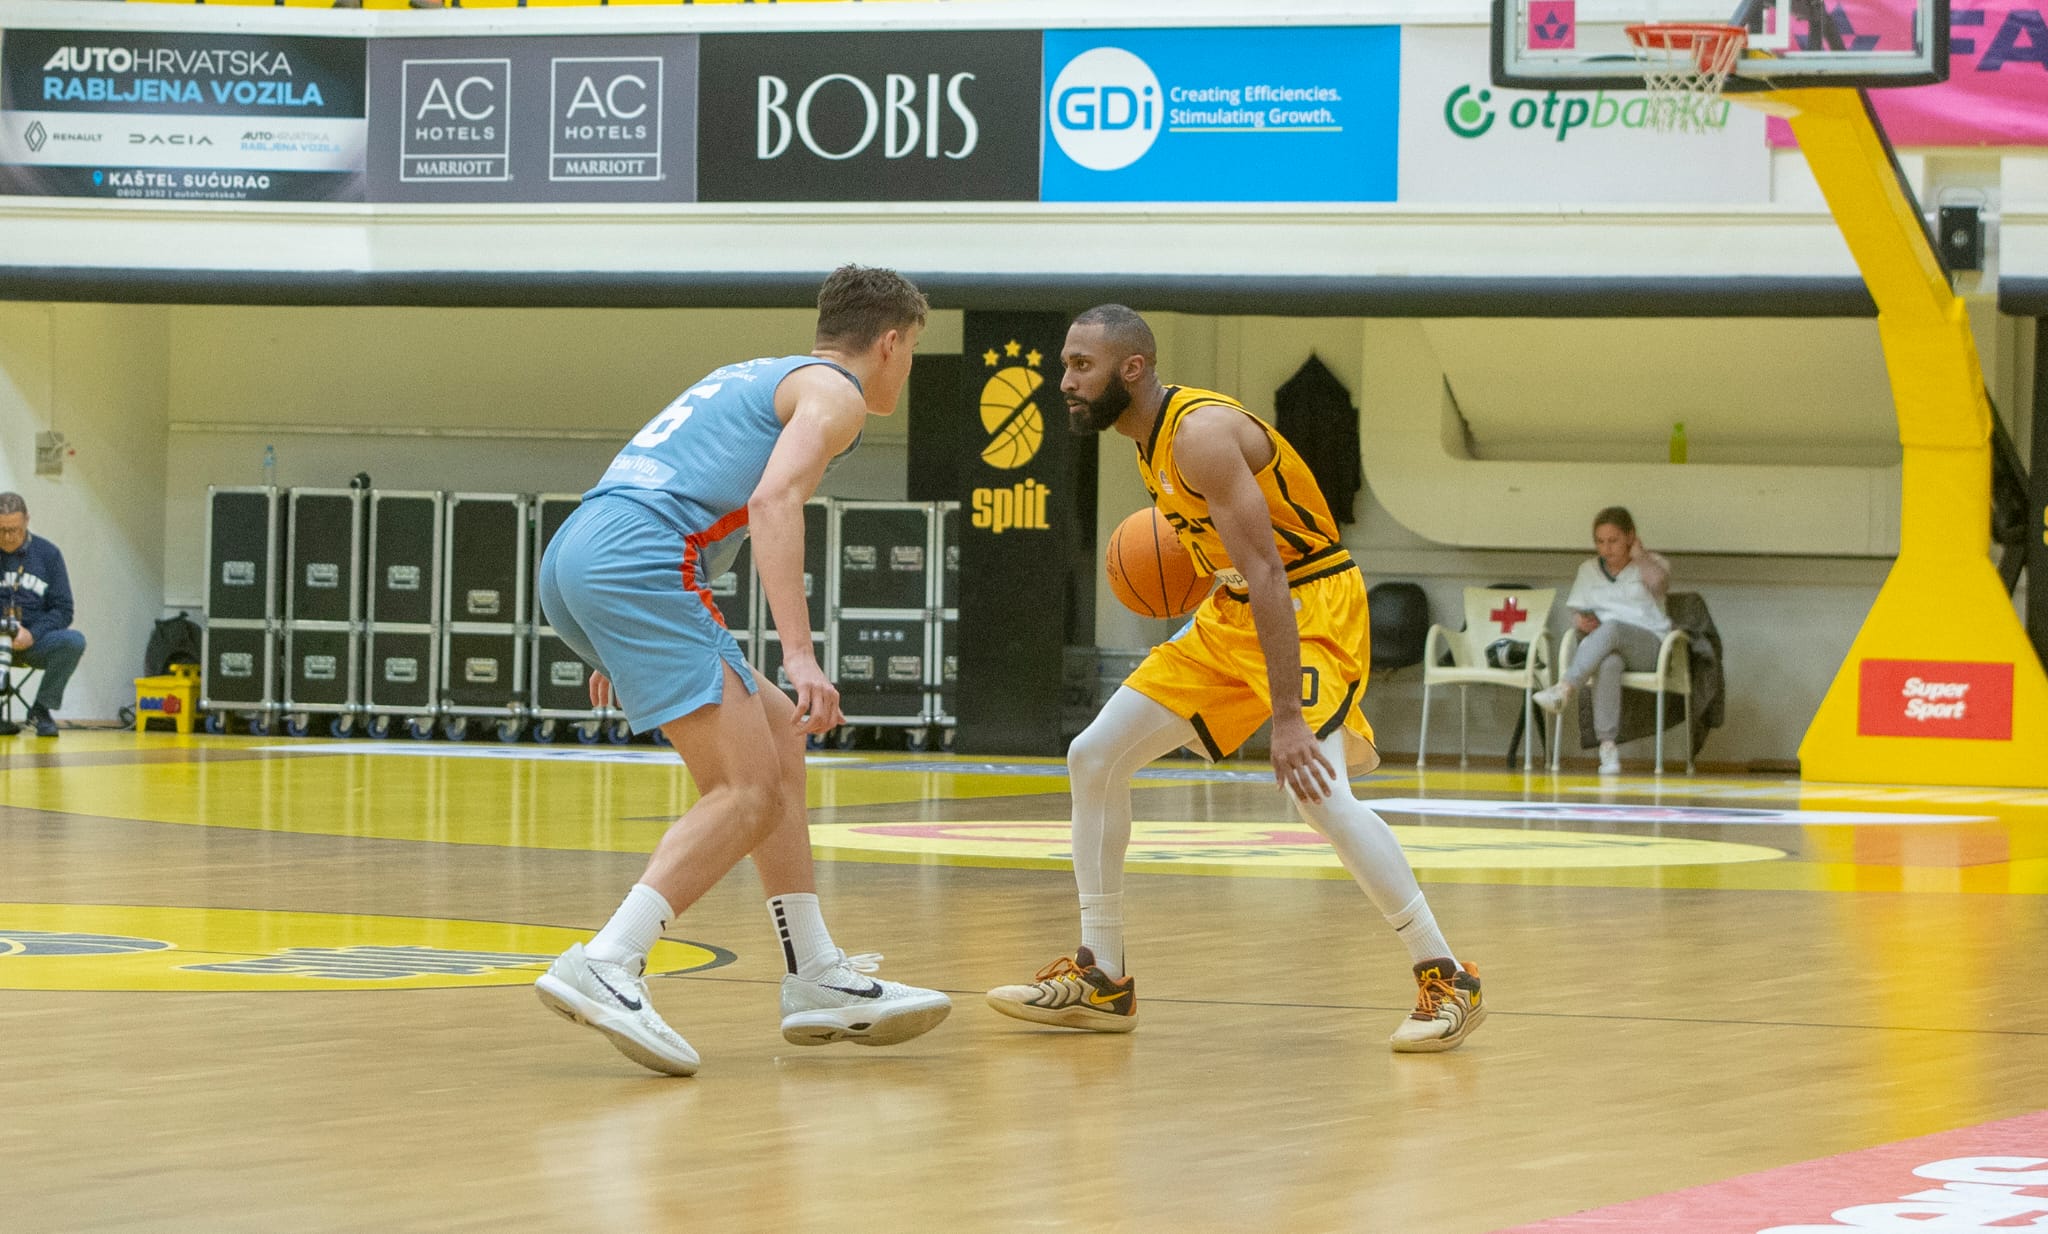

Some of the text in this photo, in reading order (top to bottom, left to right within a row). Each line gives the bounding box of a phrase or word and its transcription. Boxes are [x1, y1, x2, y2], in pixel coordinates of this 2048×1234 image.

[43, 46, 293, 76] AUTOHRVATSKA
[43, 77, 324, 107] RABLJENA VOZILA
[416, 76, 495, 121] AC
[566, 74, 647, 119] AC
[1169, 86, 1342, 105] Creating Efficiencies.
[757, 72, 980, 160] BOBIS
[1057, 86, 1155, 130] GDi
[1169, 108, 1336, 127] Stimulating Growth.
[53, 132, 103, 142] RENAULT
[129, 134, 214, 145] DACIA
[415, 127, 496, 140] HOTELS
[565, 125, 647, 139] HOTELS
[416, 161, 493, 175] MARRIOTT
[565, 159, 646, 174] MARRIOTT
[109, 170, 271, 189] KAŠTEL SUĆURAC
[972, 478, 1052, 534] split
[1902, 676, 1971, 701] Super
[1904, 698, 1967, 722] Sport
